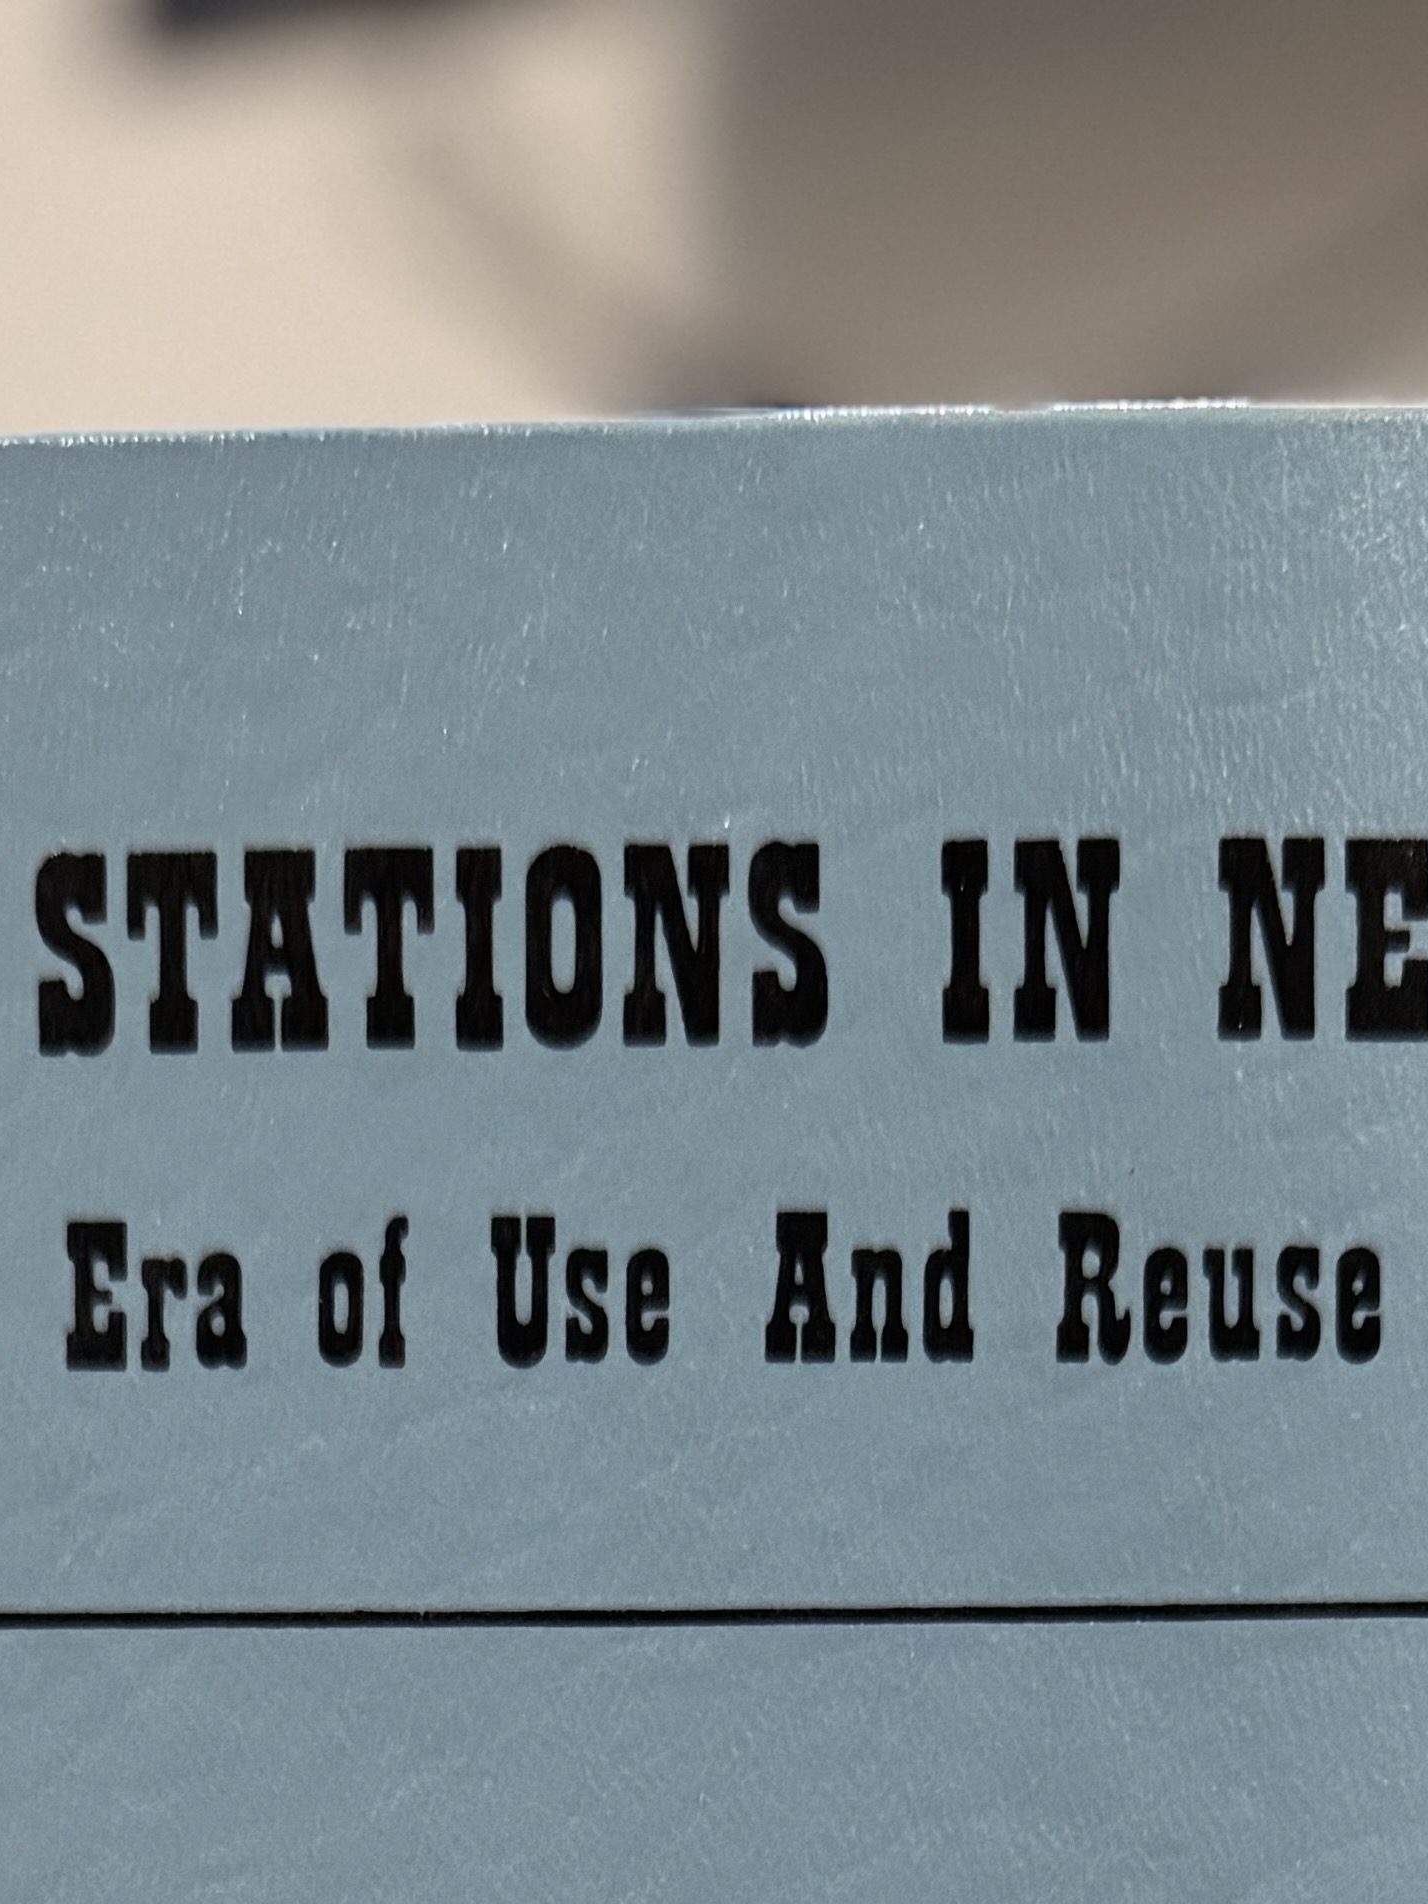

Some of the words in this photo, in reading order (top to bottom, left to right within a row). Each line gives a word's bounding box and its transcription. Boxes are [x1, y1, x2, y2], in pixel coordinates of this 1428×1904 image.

[32, 837, 831, 1059] STATIONS
[938, 835, 1123, 1046] IN
[64, 1218, 250, 1374] Era
[315, 1213, 411, 1371] of
[488, 1212, 672, 1371] Use
[762, 1207, 977, 1366] And
[1054, 1208, 1383, 1368] Reuse
